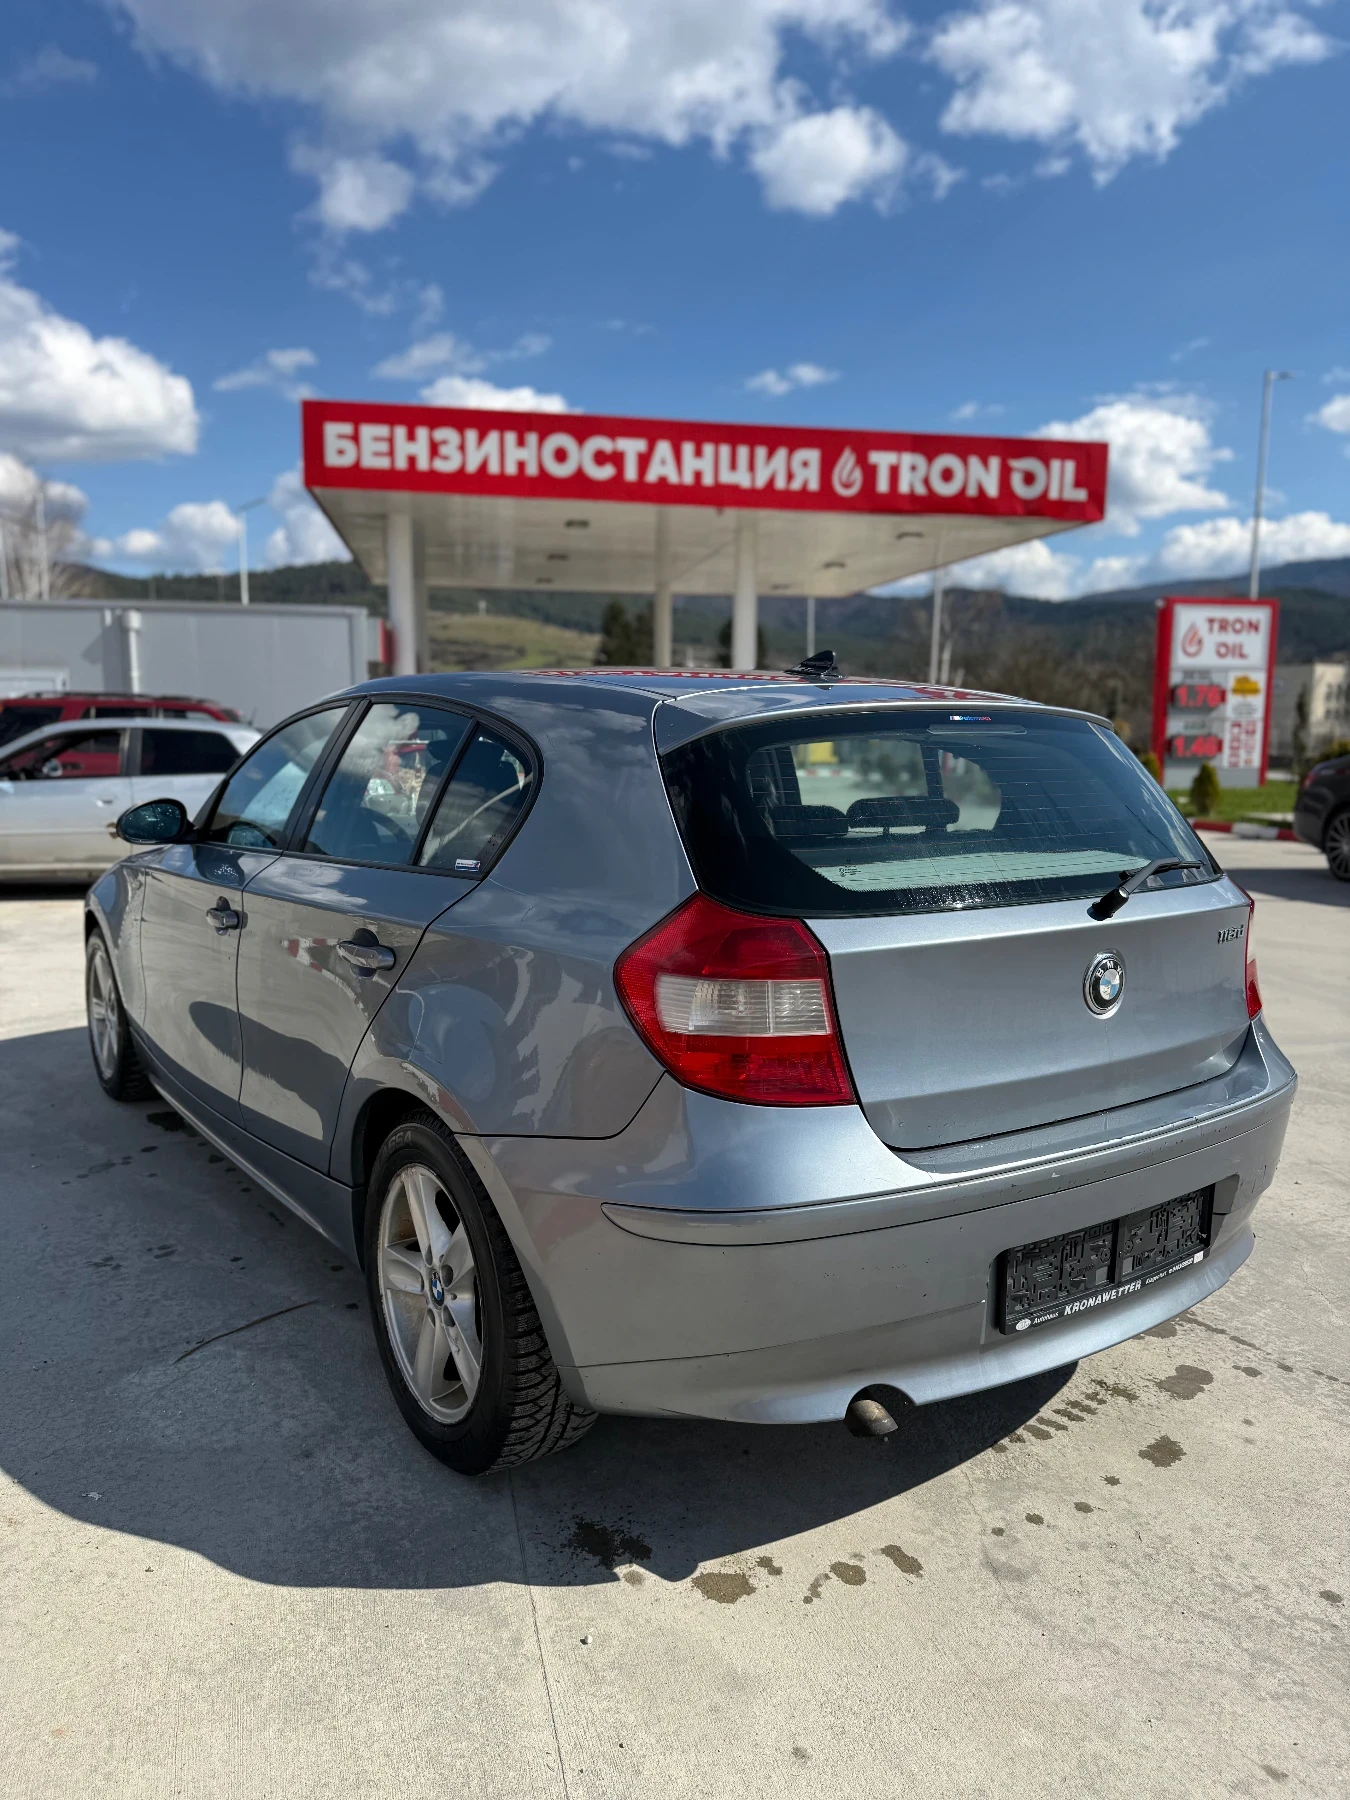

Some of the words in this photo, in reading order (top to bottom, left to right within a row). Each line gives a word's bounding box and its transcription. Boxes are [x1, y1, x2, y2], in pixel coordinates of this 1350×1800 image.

[323, 421, 821, 492] БЕНЗИНОСТАНЦИЯ
[867, 450, 1001, 498] TRON
[1007, 456, 1088, 502] OIL
[1205, 617, 1260, 634] TRON
[1215, 642, 1248, 659] OIL
[1064, 1279, 1142, 1316] KRONAWETTER
